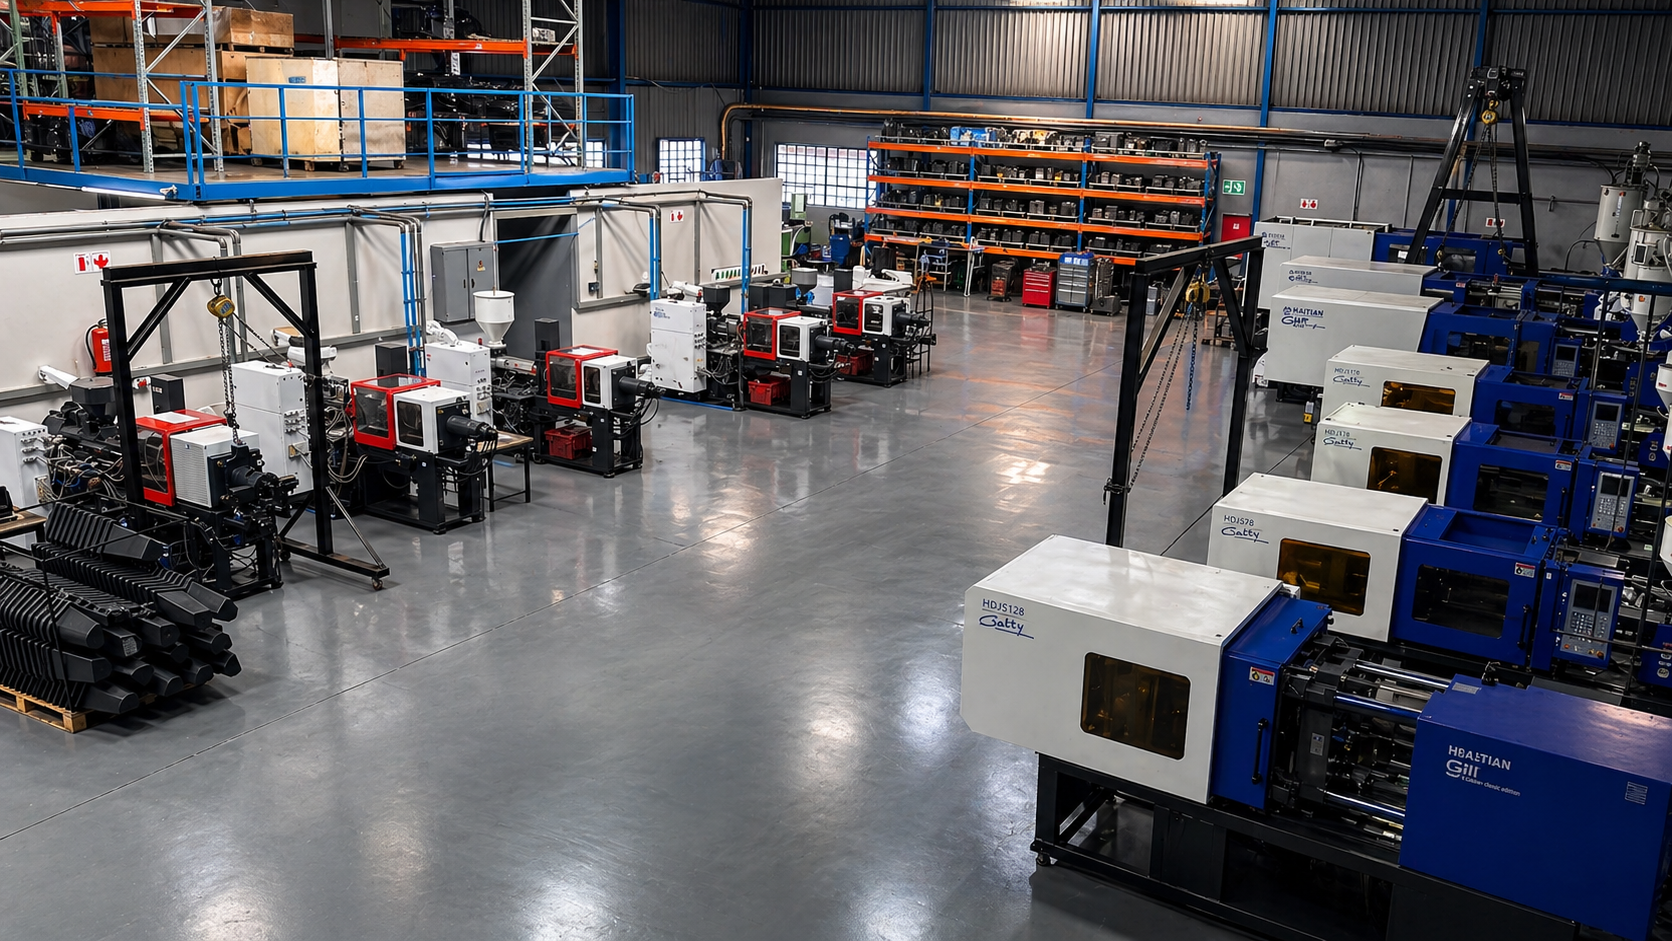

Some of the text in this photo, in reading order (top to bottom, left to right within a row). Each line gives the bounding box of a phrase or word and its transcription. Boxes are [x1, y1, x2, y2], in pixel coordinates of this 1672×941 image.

[1292, 306, 1324, 317] HAITIAN
[1221, 526, 1260, 543] Gatty
[982, 598, 1025, 616] HDJS128
[979, 614, 1024, 637] Gatty
